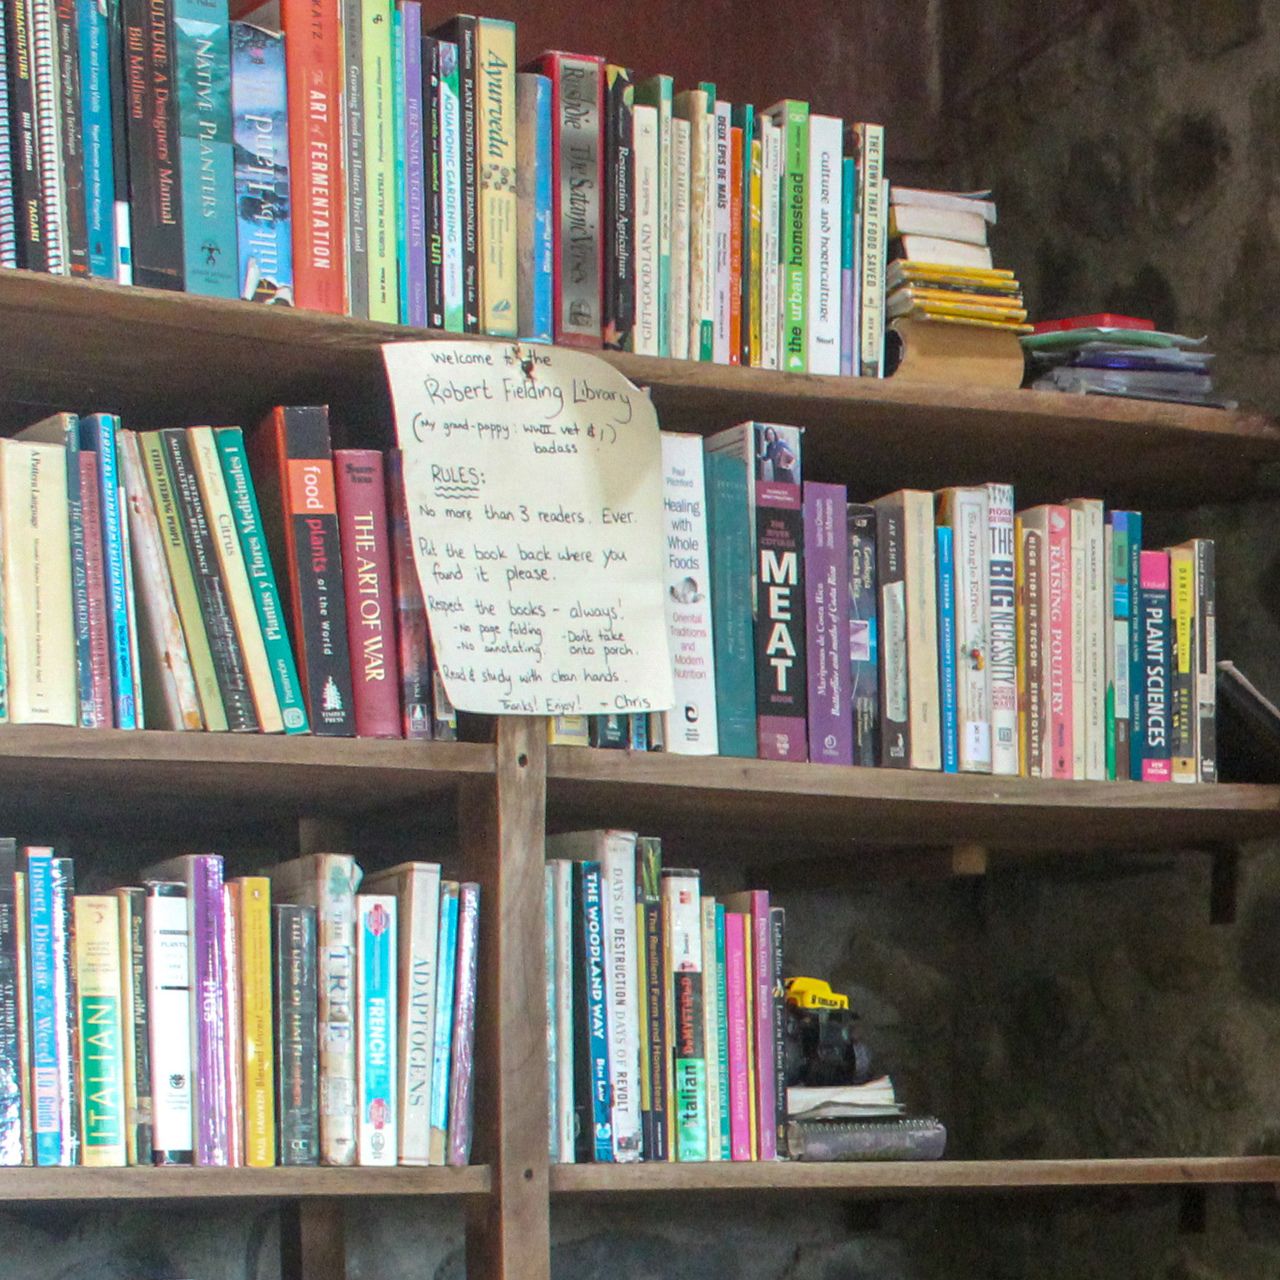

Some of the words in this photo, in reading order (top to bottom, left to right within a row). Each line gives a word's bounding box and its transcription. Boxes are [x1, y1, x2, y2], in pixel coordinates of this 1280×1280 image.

[14, 0, 30, 80] RMACULTURE
[127, 26, 142, 51] Bill
[130, 55, 145, 118] Mollison
[309, 90, 328, 123] ART
[349, 65, 361, 110] Growing
[481, 49, 509, 159] Ayurveda
[563, 65, 597, 129] Rushdie
[351, 111, 361, 135] Food
[716, 115, 728, 141] DEUX
[244, 113, 277, 192] Hand
[867, 135, 880, 155] THE
[616, 145, 630, 212] Restoration
[867, 158, 880, 188] TOWN
[159, 168, 176, 225] Manual
[310, 141, 331, 270] FERMENTATION
[562, 177, 596, 235] Satanic
[867, 191, 880, 219] THAT
[354, 227, 365, 253] Land
[788, 173, 805, 266] homestead
[867, 221, 880, 250] FOOD
[430, 234, 442, 265] run
[617, 214, 630, 279] Agriculture
[867, 253, 880, 288] SAVED
[788, 271, 803, 321] urban
[527, 350, 553, 367] the
[788, 326, 802, 354] the
[424, 376, 494, 406] Robert
[503, 378, 564, 420] Fielding
[573, 378, 633, 425] Library
[533, 440, 579, 454] badass
[303, 465, 323, 509] food
[431, 464, 486, 485] RULES:
[187, 473, 209, 538] SUSTAINABLE
[484, 504, 516, 522] than
[518, 505, 530, 523] 3
[664, 498, 701, 517] Healing
[670, 519, 693, 533] with
[188, 517, 210, 576] RESISTANCE
[217, 513, 238, 558] Citrus
[305, 518, 328, 573] plants
[353, 510, 377, 552] THE
[667, 537, 699, 552] Whole
[989, 528, 1014, 555] THE
[247, 536, 270, 577] Flores
[431, 562, 463, 585] found
[474, 565, 489, 583] it
[446, 543, 466, 560] the
[473, 544, 508, 562] book
[517, 543, 552, 562] back
[557, 546, 594, 563] where
[603, 547, 628, 569] you
[668, 556, 700, 571] Foods
[356, 557, 380, 598] ART
[989, 560, 1015, 608] BIG
[1050, 544, 1063, 622] RAISING
[261, 592, 282, 641] Plantas
[360, 599, 382, 631] OF
[475, 599, 496, 616] the
[508, 600, 547, 617] books
[760, 549, 798, 692] MEAT
[479, 623, 501, 645] page
[508, 621, 543, 646] folding
[568, 644, 595, 656] onto
[598, 629, 625, 642] take
[990, 610, 1015, 686] NECESSITY
[1146, 608, 1165, 664] PLANT
[362, 635, 385, 682] WAR
[1051, 629, 1064, 717] POULTRY
[482, 666, 513, 697] study
[519, 668, 543, 683] with
[612, 693, 652, 711] Chris
[1146, 666, 1166, 747] SCIENCES
[586, 872, 600, 904] THE
[589, 905, 604, 1001] WOODLAND
[613, 928, 627, 1007] DESTRUCTION
[367, 997, 387, 1066] FRENCH
[408, 956, 431, 1107] ADAPTOGENS
[591, 1003, 605, 1040] WAY
[86, 1003, 117, 1139] ITALIAN
[616, 1071, 629, 1114] REVOLT
